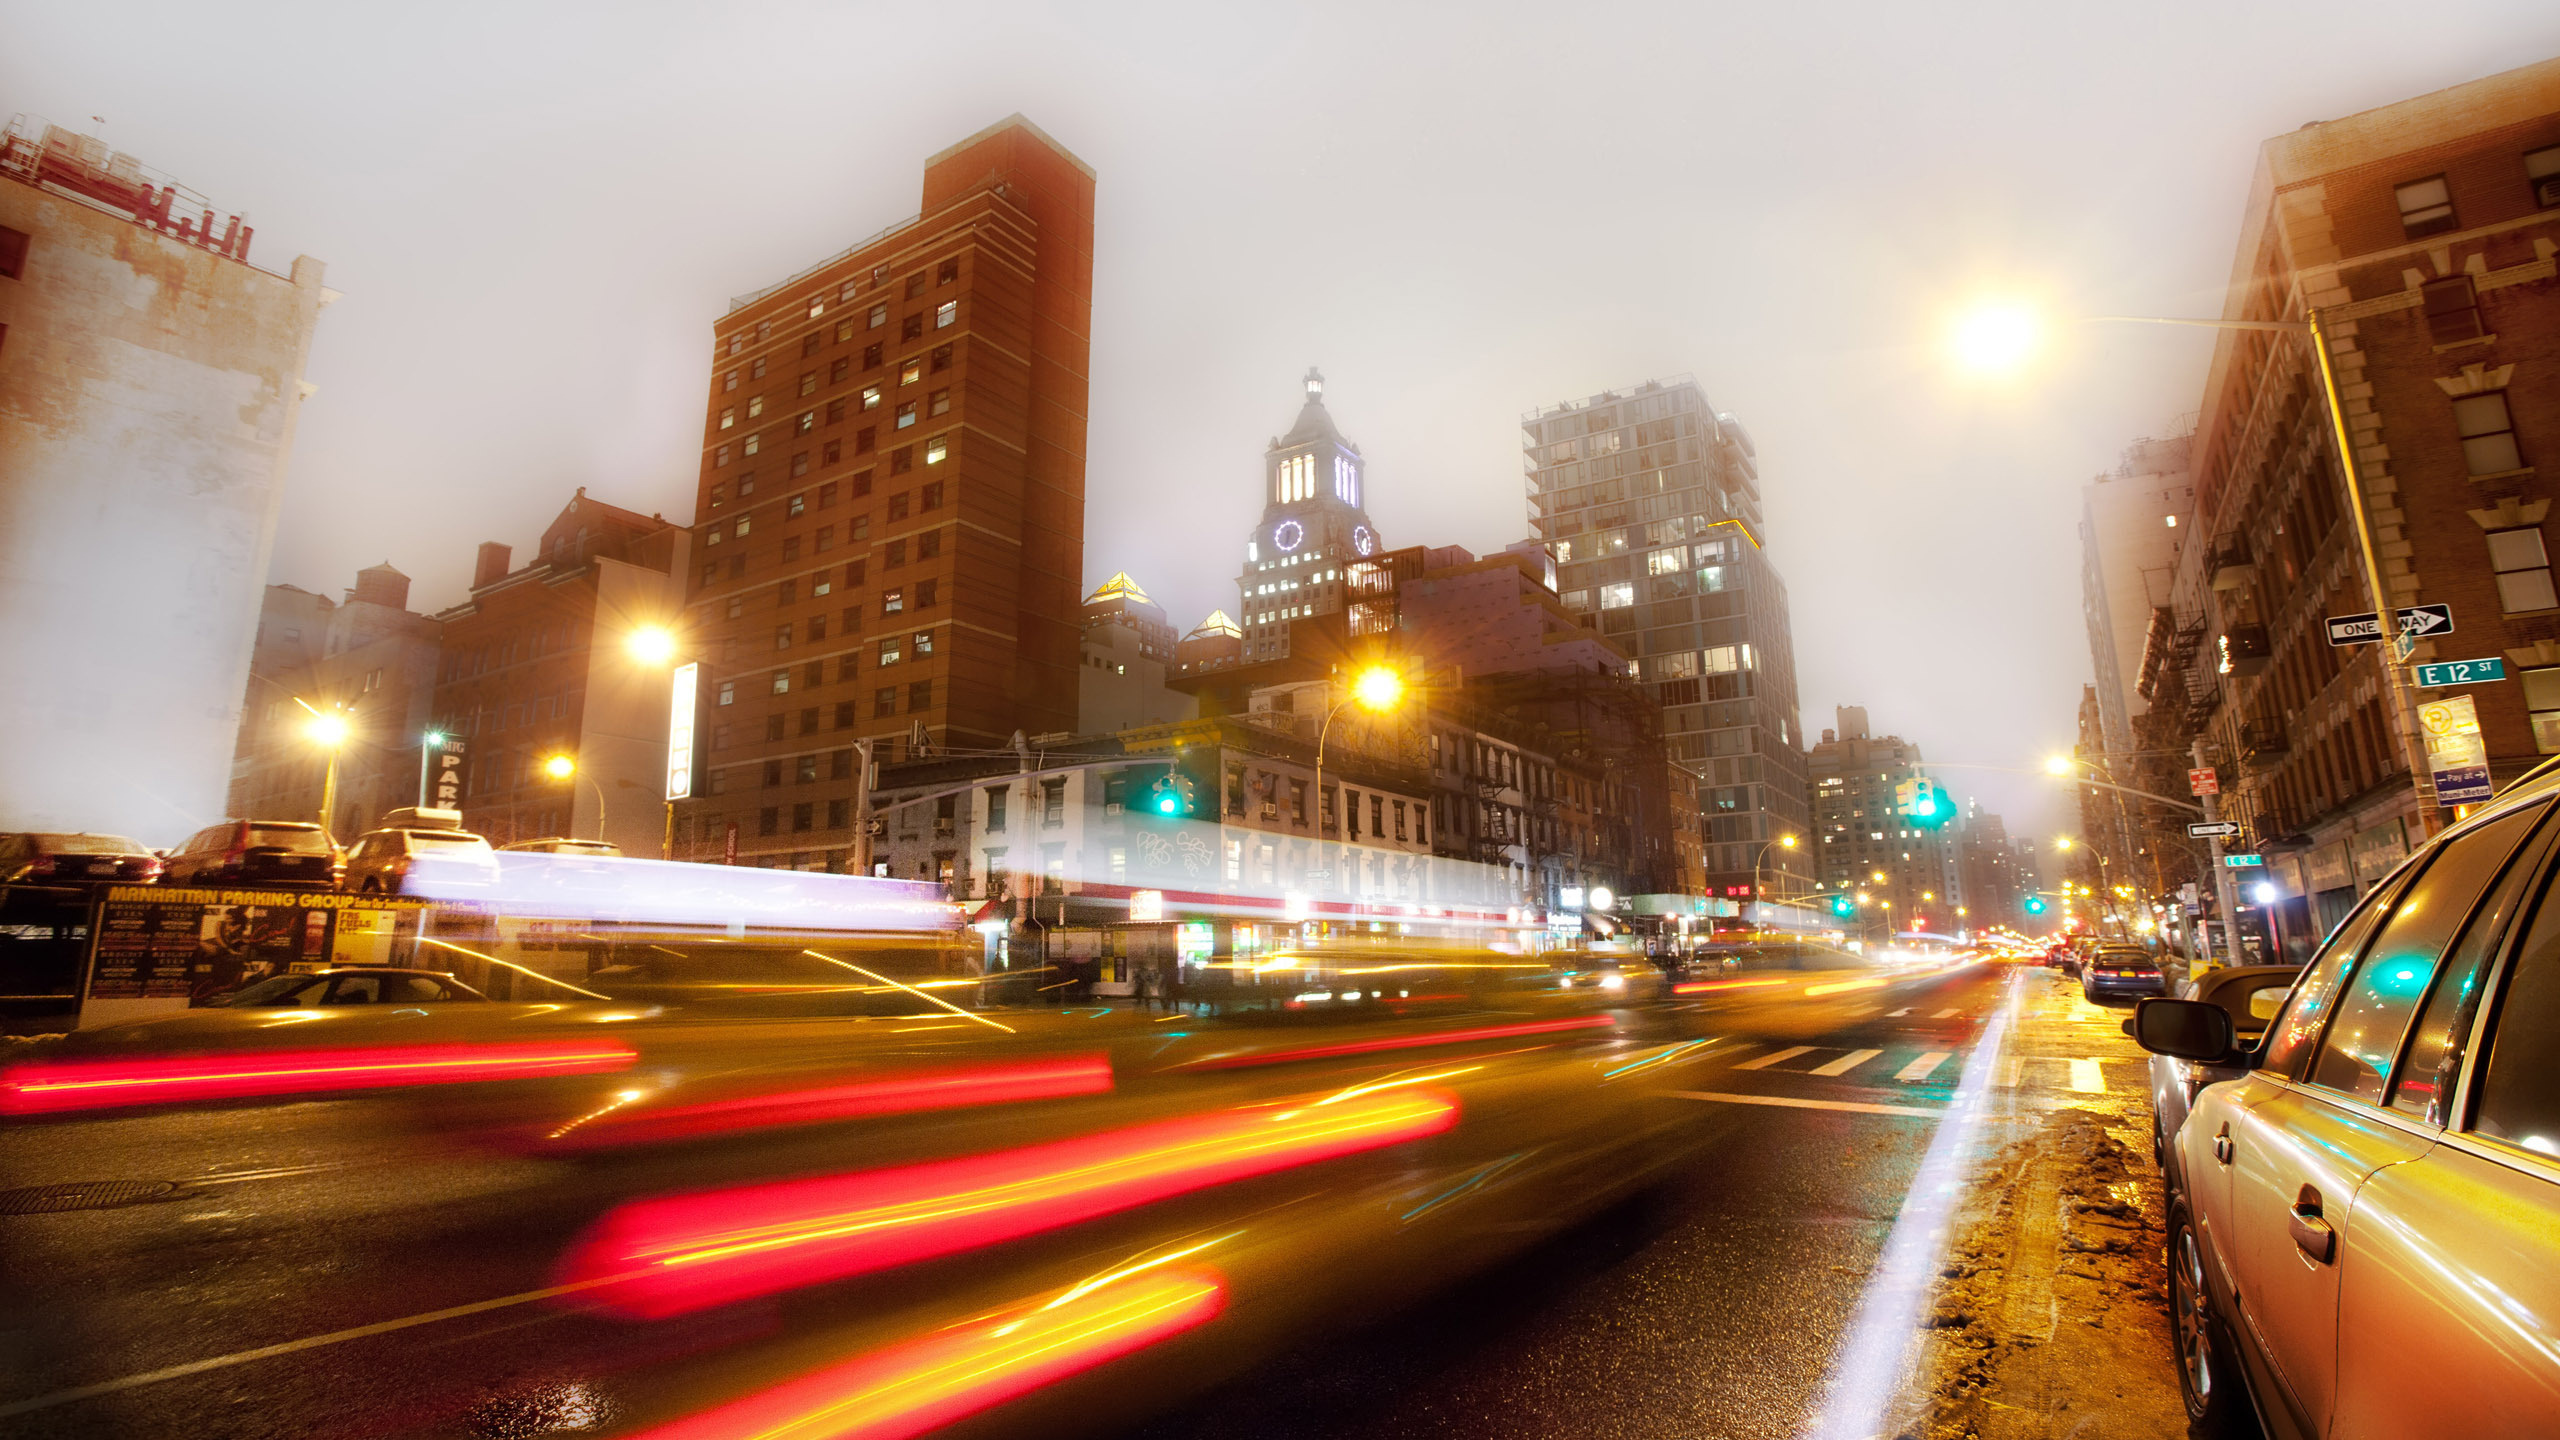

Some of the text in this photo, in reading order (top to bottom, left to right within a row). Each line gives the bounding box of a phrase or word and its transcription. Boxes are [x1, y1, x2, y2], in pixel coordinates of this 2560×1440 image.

[2344, 615, 2431, 636] ONE WAY
[2425, 662, 2492, 684] E 12 ST
[2447, 772, 2474, 784] Pay at
[2440, 788, 2489, 799] Muni-Meter
[2239, 856, 2248, 866] 12
[108, 886, 218, 904] MANHATTAN
[221, 890, 296, 907] PARKING
[300, 893, 354, 908] GROUP
